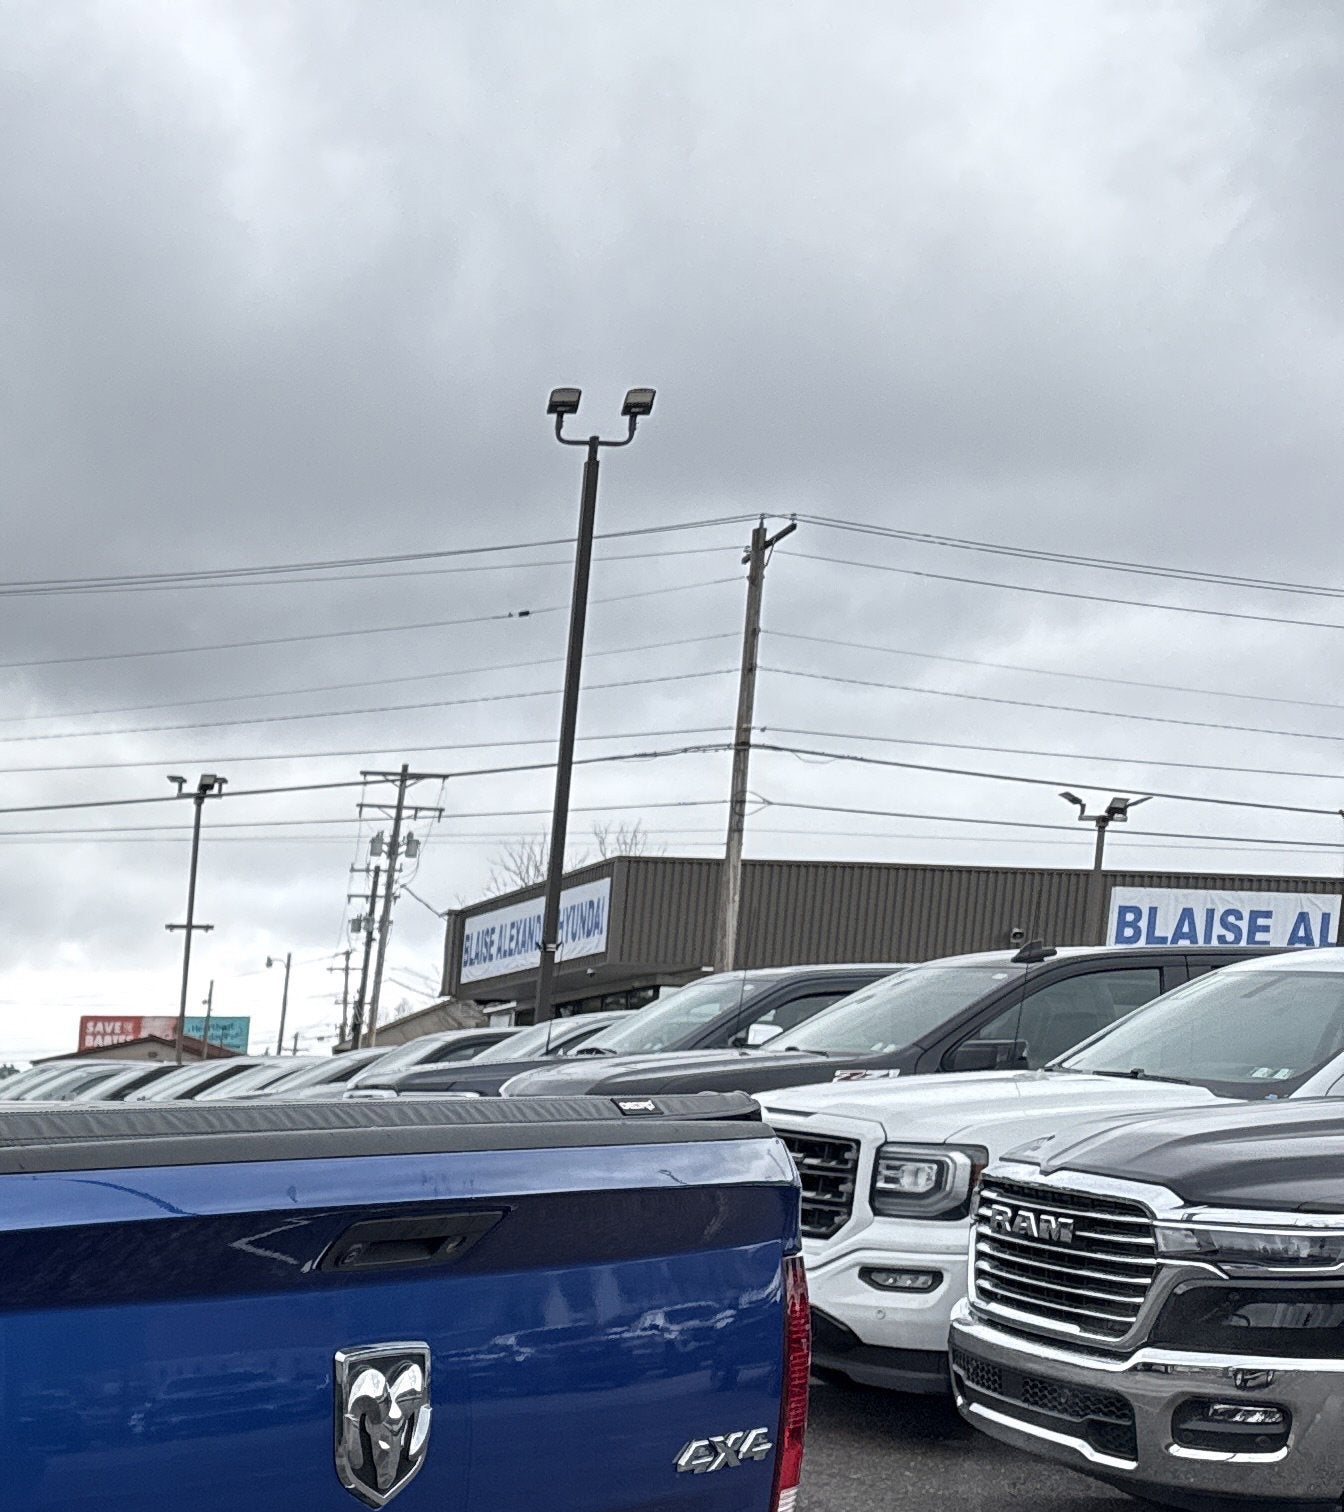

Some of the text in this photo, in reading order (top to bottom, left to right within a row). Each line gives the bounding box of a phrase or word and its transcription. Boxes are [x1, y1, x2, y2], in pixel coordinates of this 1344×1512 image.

[463, 926, 496, 969] BLAISE
[495, 914, 543, 960] ALEXAND
[1114, 905, 1273, 946] BLAISE
[86, 1021, 122, 1034] SAVE
[991, 1203, 1074, 1244] RAM
